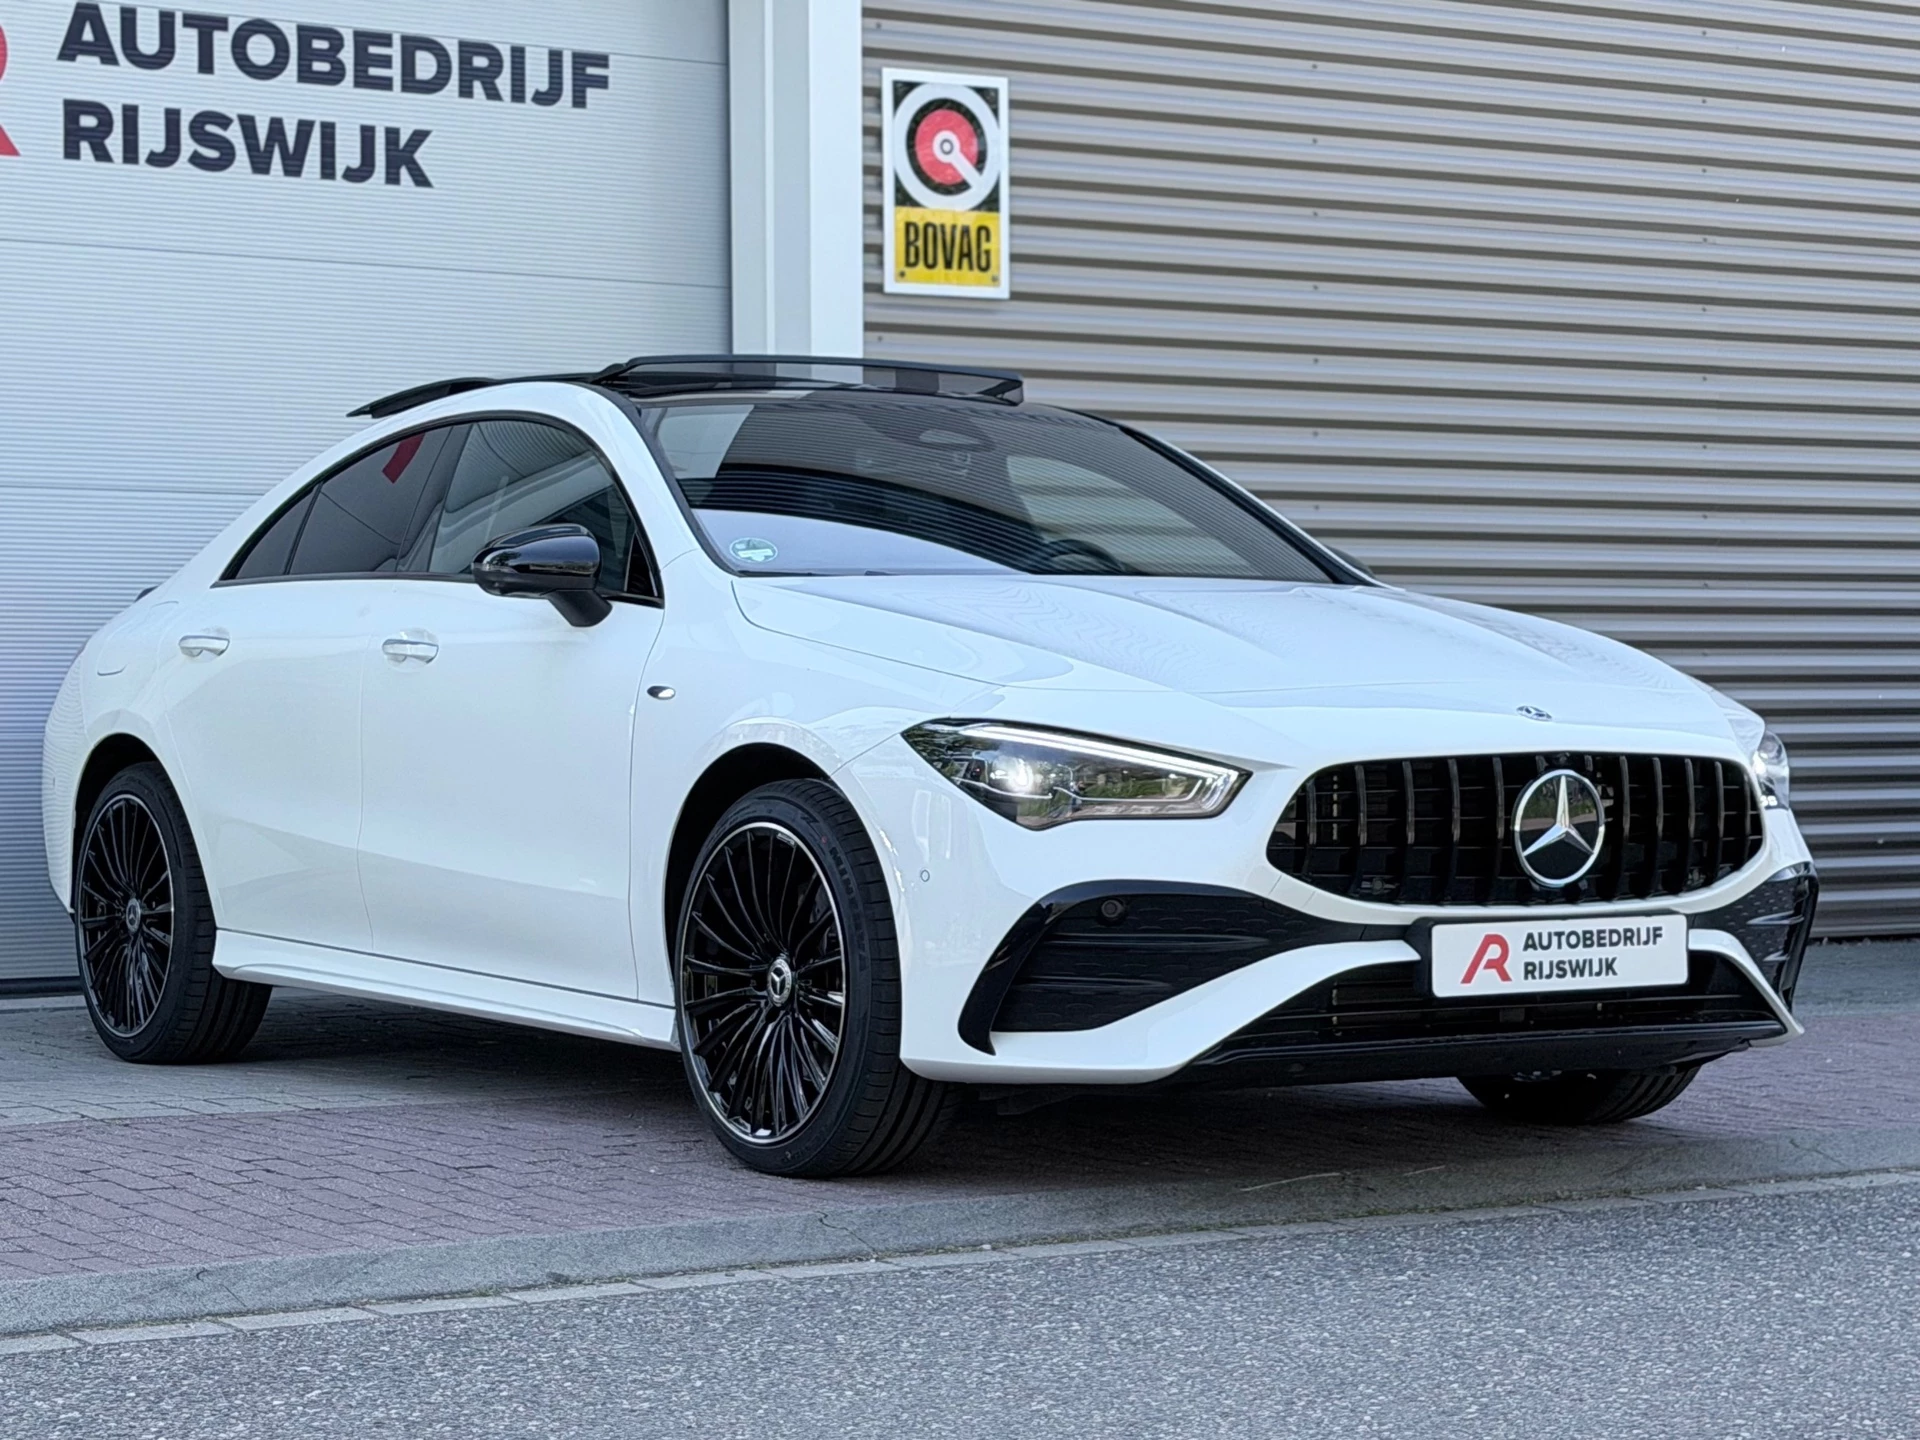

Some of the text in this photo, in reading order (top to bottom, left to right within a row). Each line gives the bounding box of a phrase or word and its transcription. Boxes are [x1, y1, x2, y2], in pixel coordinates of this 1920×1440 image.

[57, 2, 609, 109] AUTOBEDRIJF
[62, 98, 434, 188] RIJSWIJK
[904, 221, 991, 273] BOVAG
[1522, 926, 1663, 952] AUTOBEDRIJF
[1523, 956, 1618, 981] RIJSWIJK
